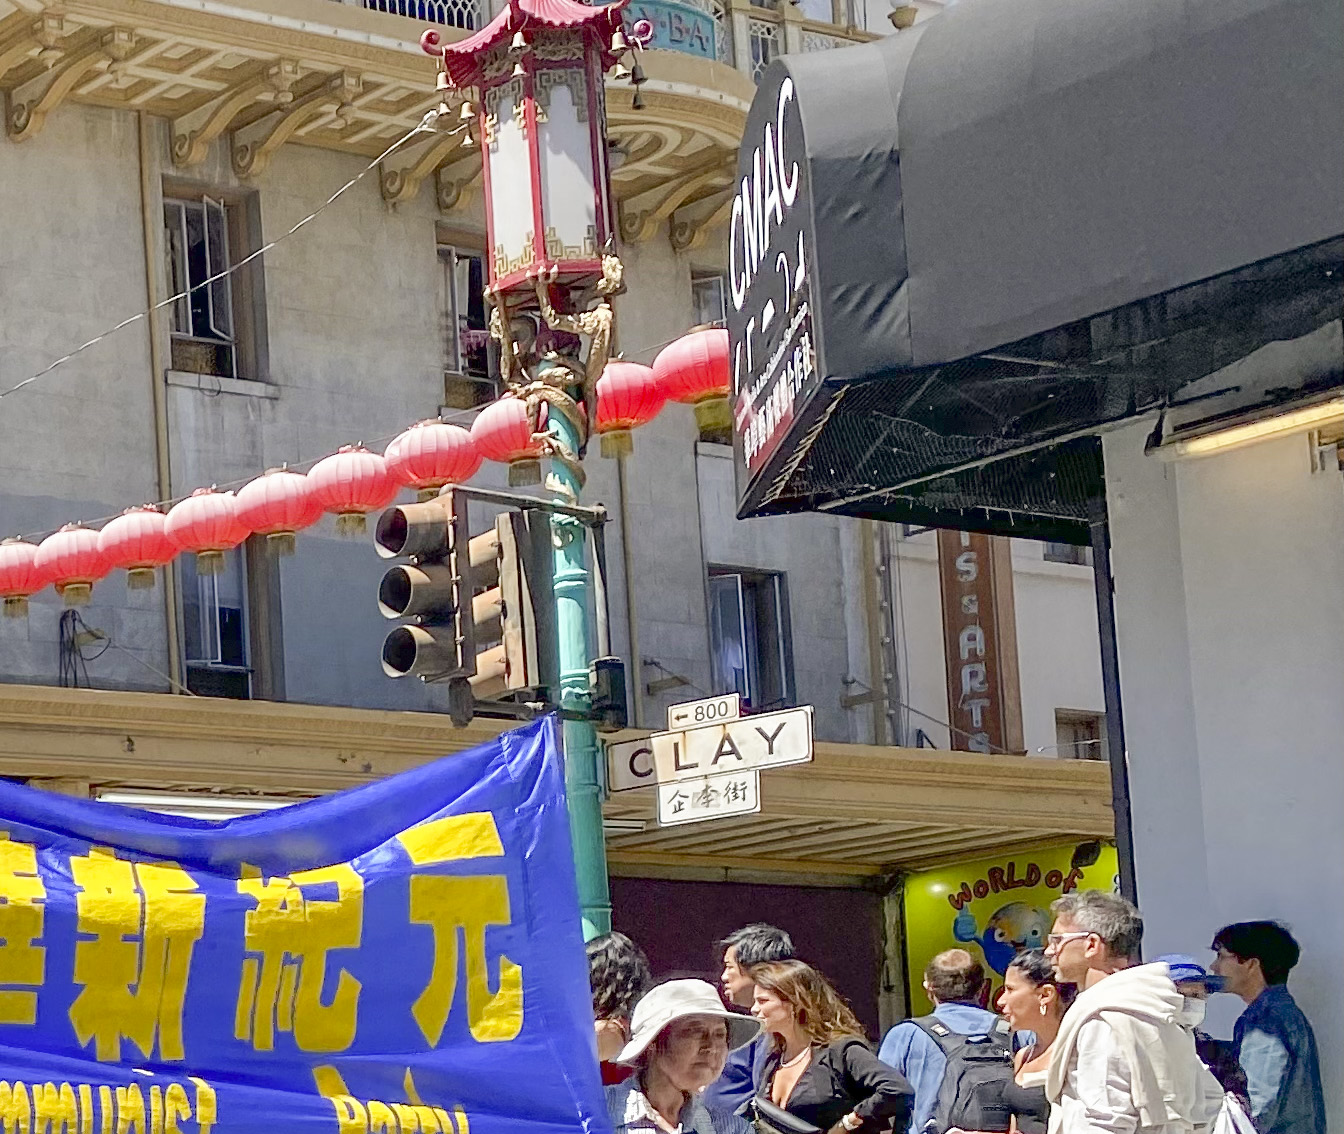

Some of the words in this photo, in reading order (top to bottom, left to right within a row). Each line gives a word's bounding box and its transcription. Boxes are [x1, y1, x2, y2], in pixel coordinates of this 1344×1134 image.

[729, 76, 799, 312] CMAC
[694, 701, 728, 722] 800
[628, 721, 787, 778] CLAY
